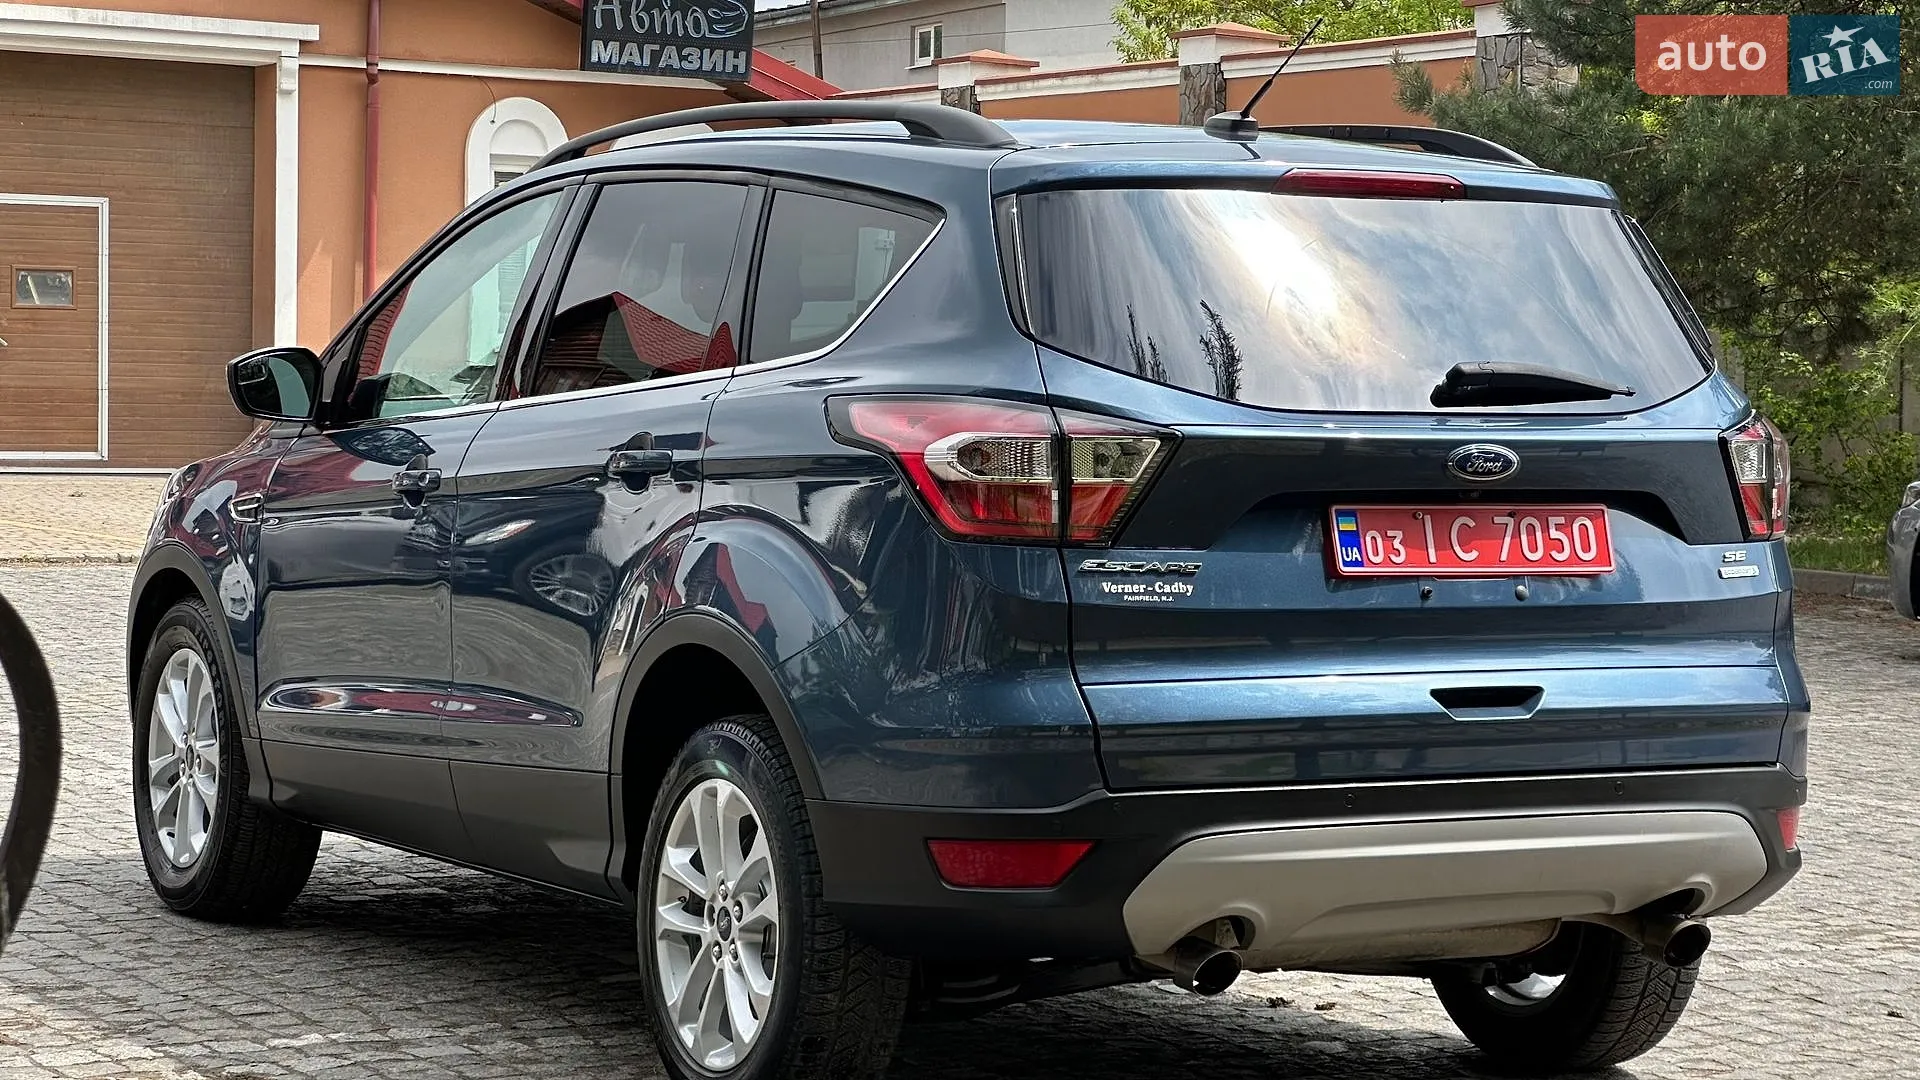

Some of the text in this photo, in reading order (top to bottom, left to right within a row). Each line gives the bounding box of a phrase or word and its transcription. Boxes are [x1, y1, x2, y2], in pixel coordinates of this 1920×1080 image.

[590, 40, 747, 74] МАГАЗИН
[1466, 453, 1504, 473] Ford
[1365, 530, 1407, 564] 03
[1491, 516, 1598, 562] 7050
[1342, 546, 1361, 562] UA
[1723, 550, 1747, 562] SE
[1079, 559, 1202, 575] ESCAPE
